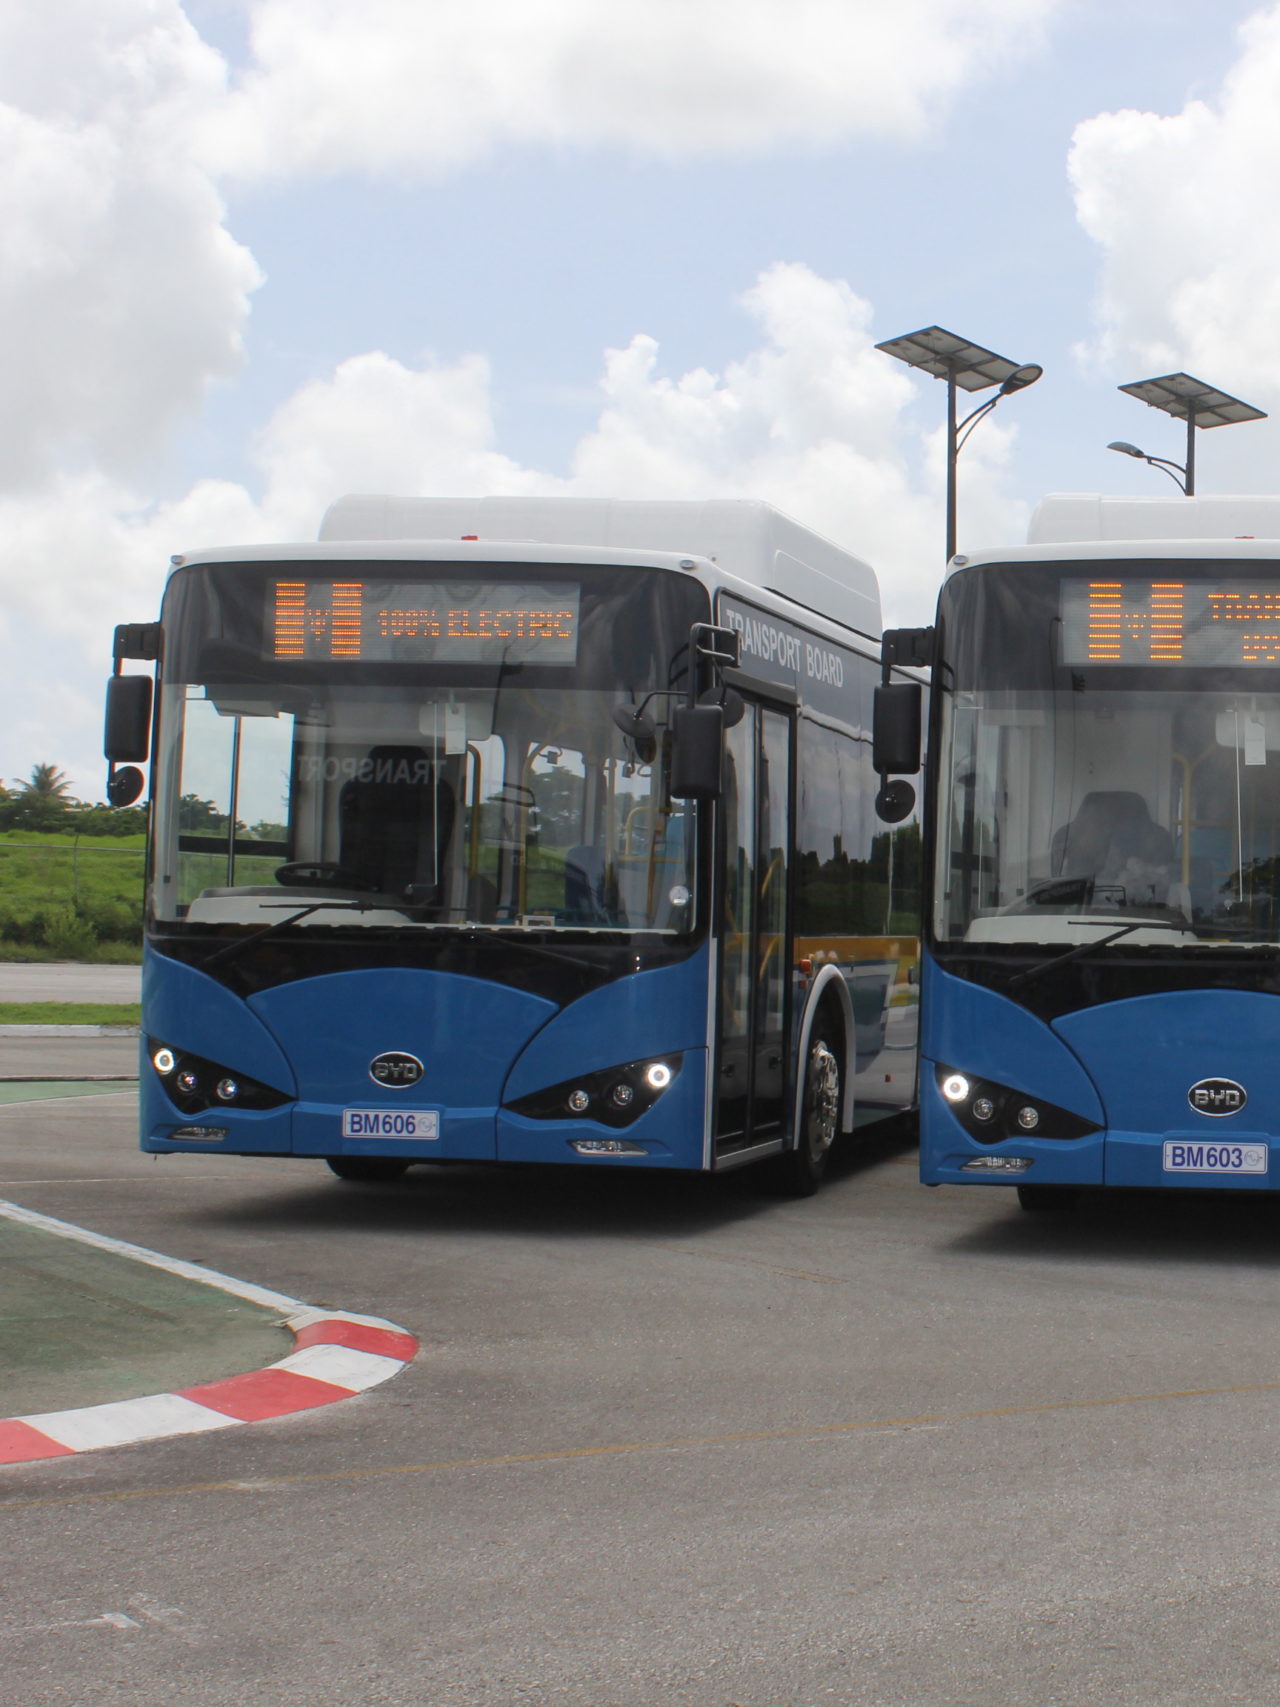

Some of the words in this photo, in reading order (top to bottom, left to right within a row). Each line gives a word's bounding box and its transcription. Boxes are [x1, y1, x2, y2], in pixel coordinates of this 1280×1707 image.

[726, 609, 801, 673] TRANSPORT
[805, 643, 844, 688] BOARD
[374, 1062, 418, 1079] BYD
[1194, 1089, 1240, 1106] BYD
